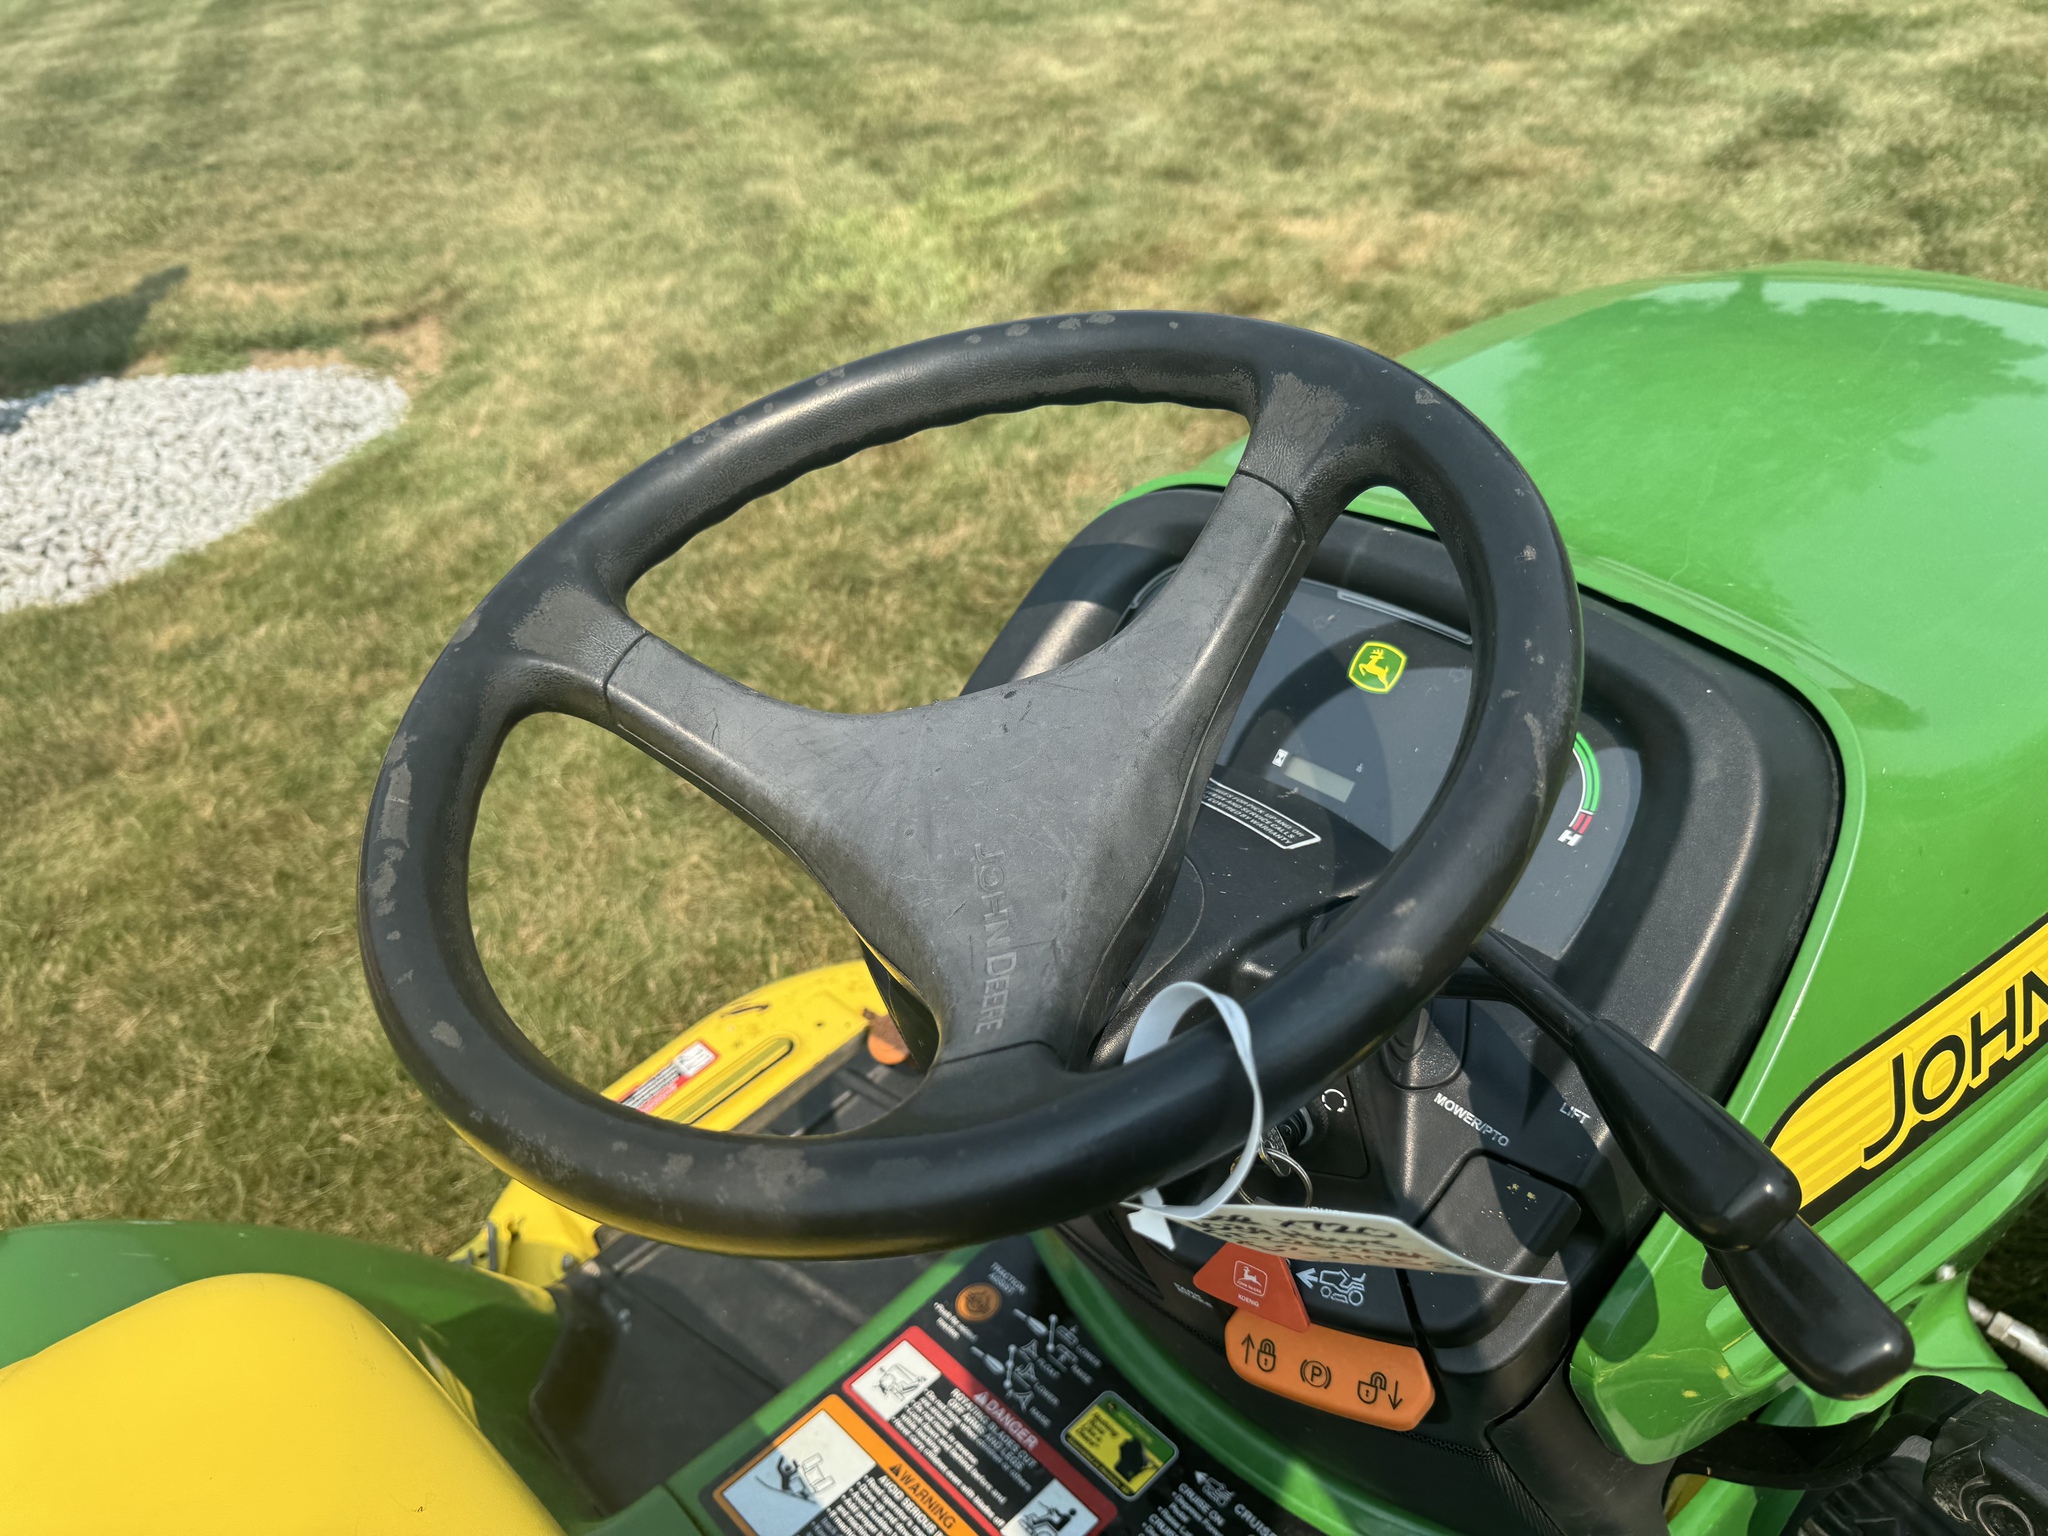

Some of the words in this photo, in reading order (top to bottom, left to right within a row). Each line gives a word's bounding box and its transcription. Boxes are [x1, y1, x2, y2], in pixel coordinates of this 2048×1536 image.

[1207, 795, 1240, 816] COVERED
[1248, 818, 1293, 846] WARRANTY
[1226, 799, 1241, 810] AND
[1240, 806, 1270, 825] SERVICE
[1269, 822, 1295, 839] CALLS
[1557, 829, 1583, 847] H
[974, 843, 1010, 948] JOHN
[974, 951, 1017, 1035] DEERE
[1433, 1092, 1510, 1148] MOWER/PTO
[1559, 1101, 1592, 1125] LIFT
[1236, 1293, 1260, 1307] KOENIG
[983, 1397, 1040, 1452] DANGER
[875, 1473, 905, 1502] AVOID
[898, 1495, 939, 1535] SERIOUS
[897, 1470, 957, 1529] WARNING
